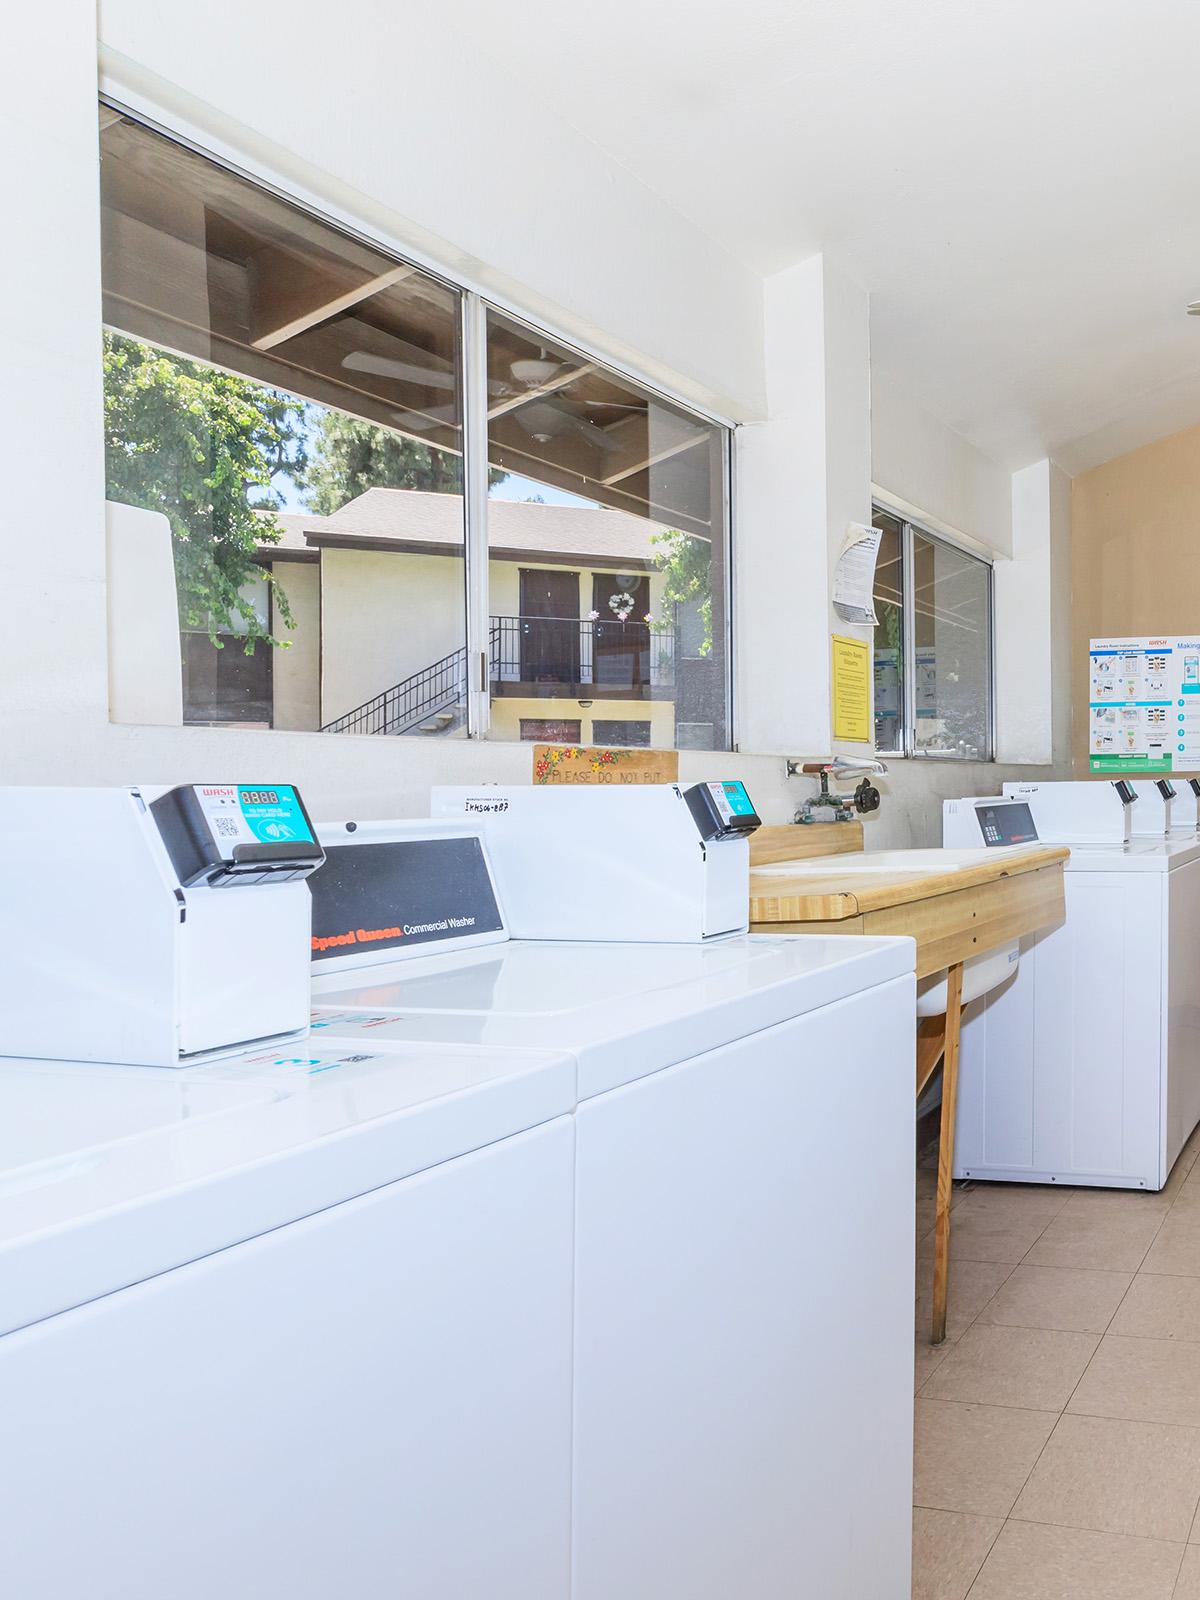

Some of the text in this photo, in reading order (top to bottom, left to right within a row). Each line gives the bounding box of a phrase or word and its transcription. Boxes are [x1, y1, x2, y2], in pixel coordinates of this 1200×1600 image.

[552, 769, 661, 783] PLEASE DO NOT PUT
[311, 916, 476, 951] Speed Queen Commercial Washer
